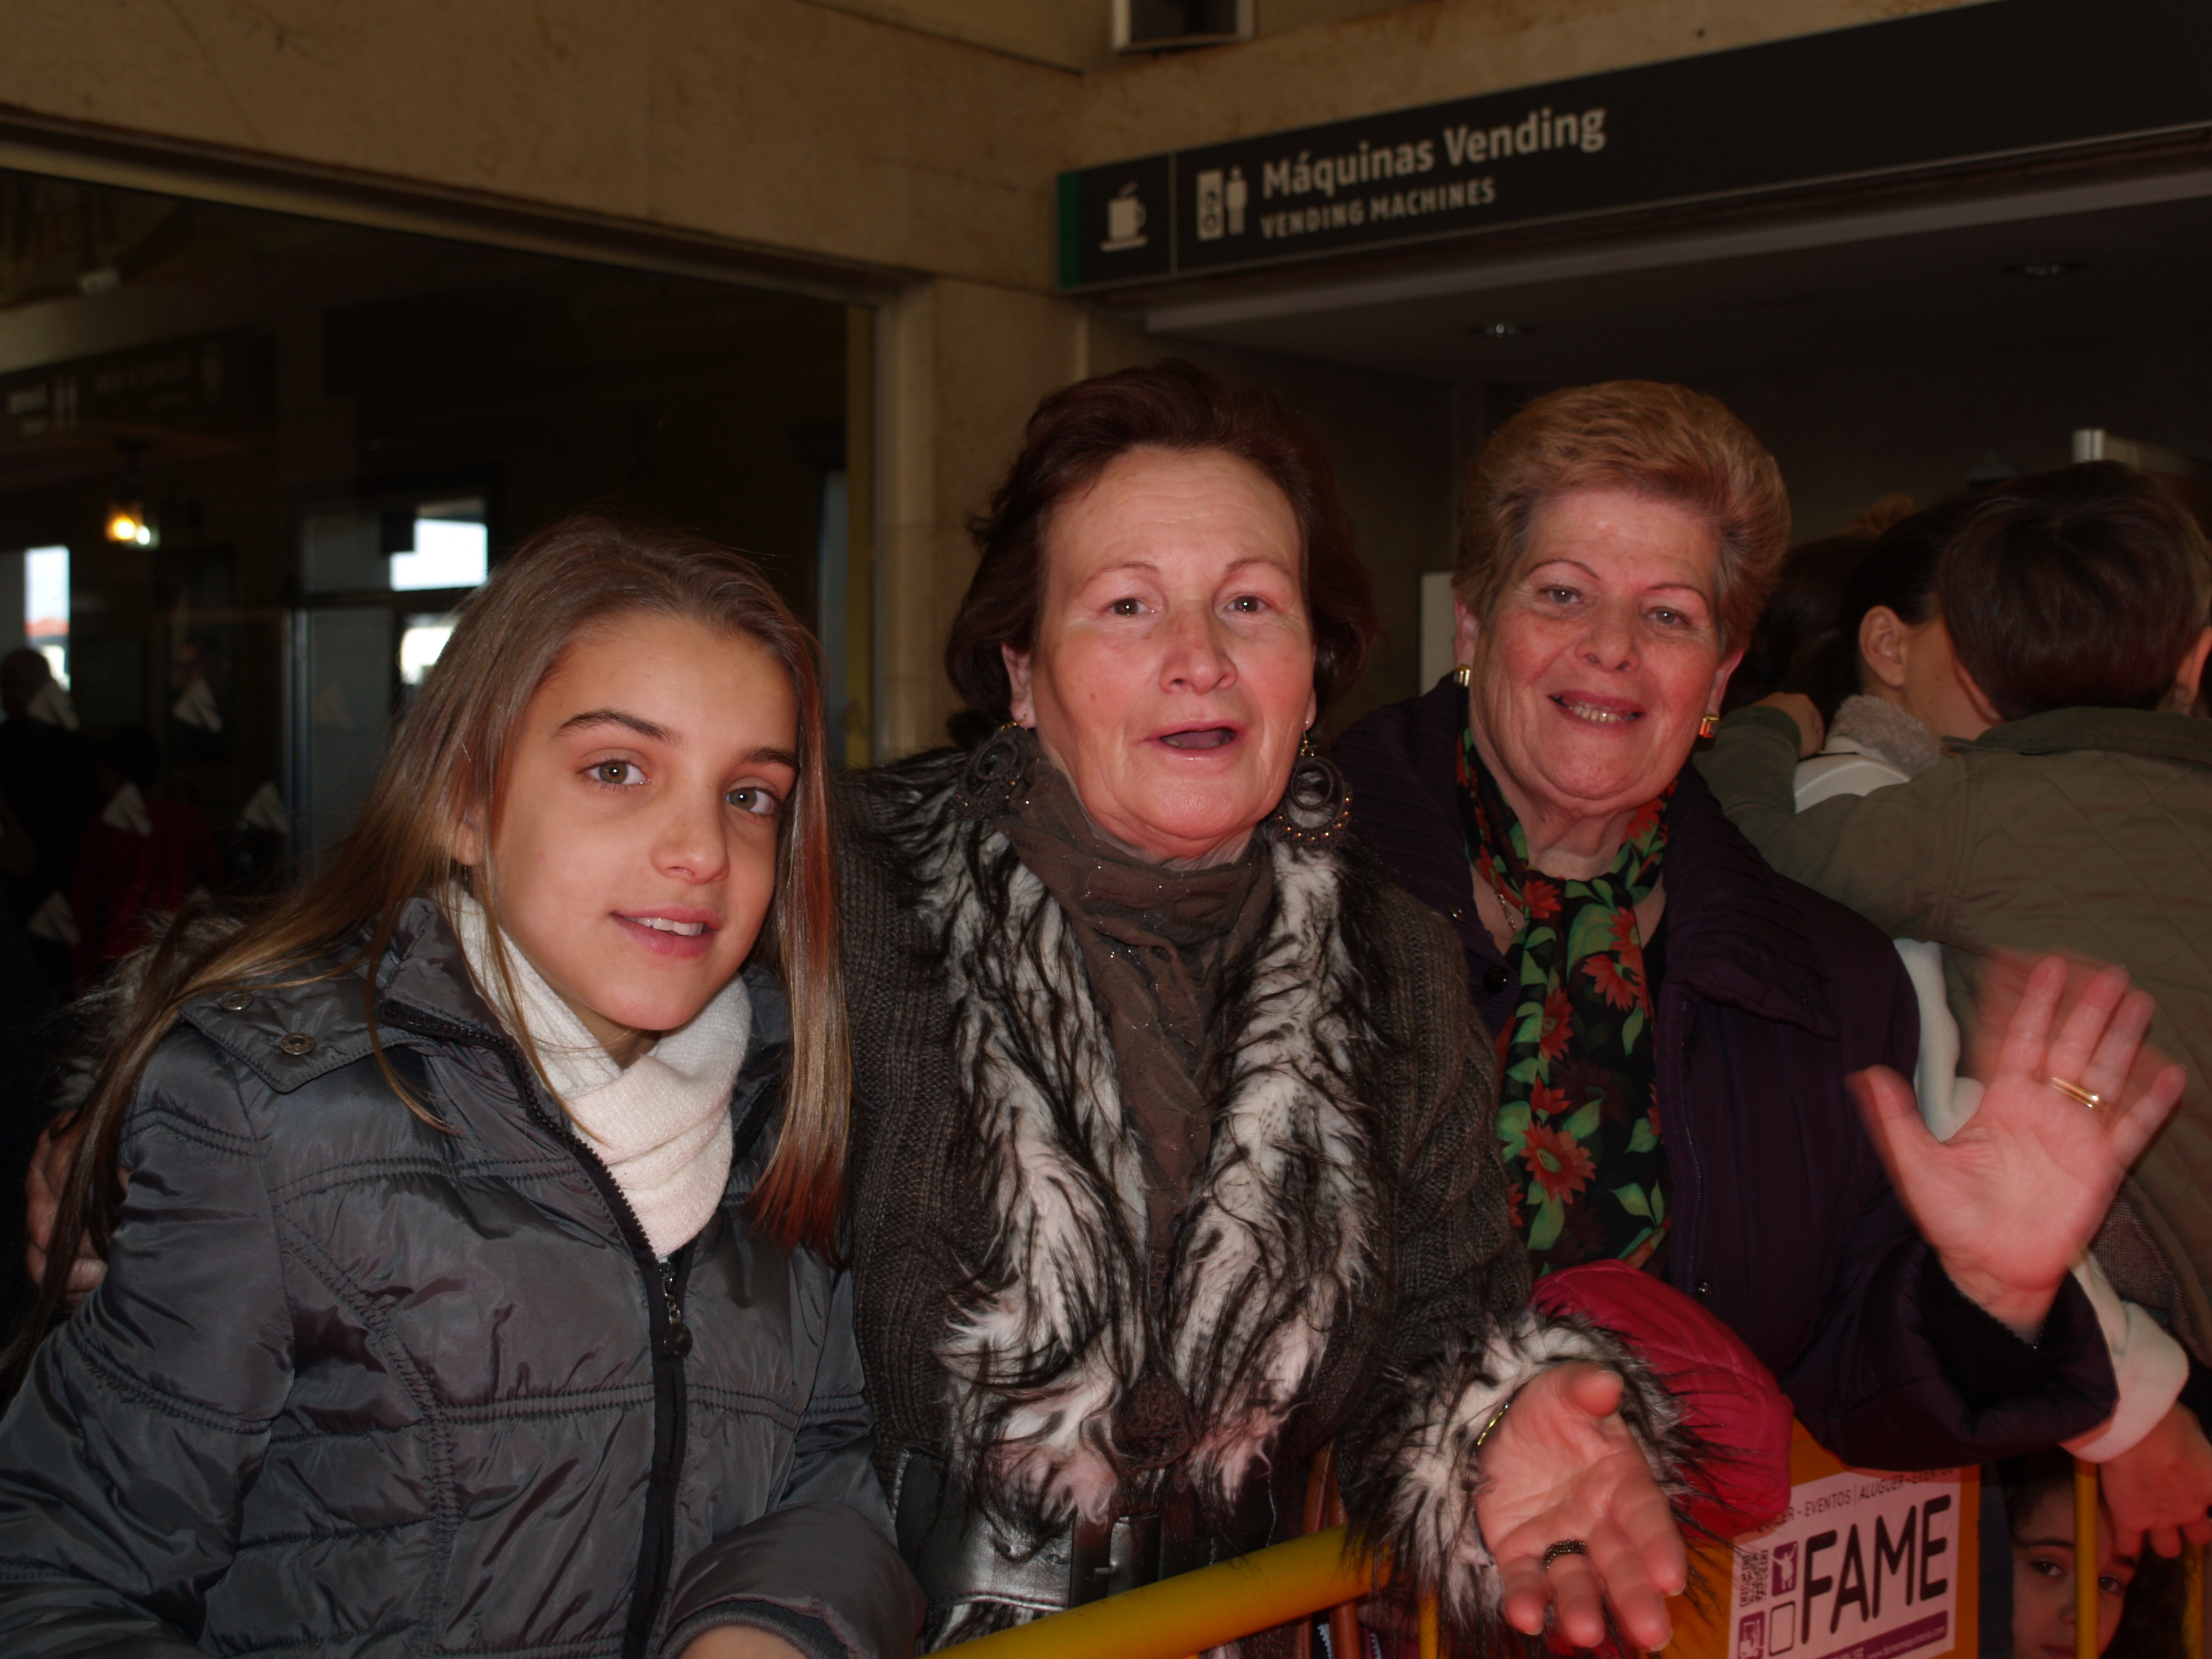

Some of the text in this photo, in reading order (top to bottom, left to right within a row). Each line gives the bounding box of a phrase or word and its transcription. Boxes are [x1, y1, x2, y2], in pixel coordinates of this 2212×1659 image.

[1262, 106, 1607, 199] Máquinas Vending
[1260, 176, 1496, 240] VENDING MACHINES
[1805, 1489, 1851, 1517] EVENTOS
[1858, 1474, 1904, 1501] ALUGUER
[1801, 1493, 1952, 1645] FAME
